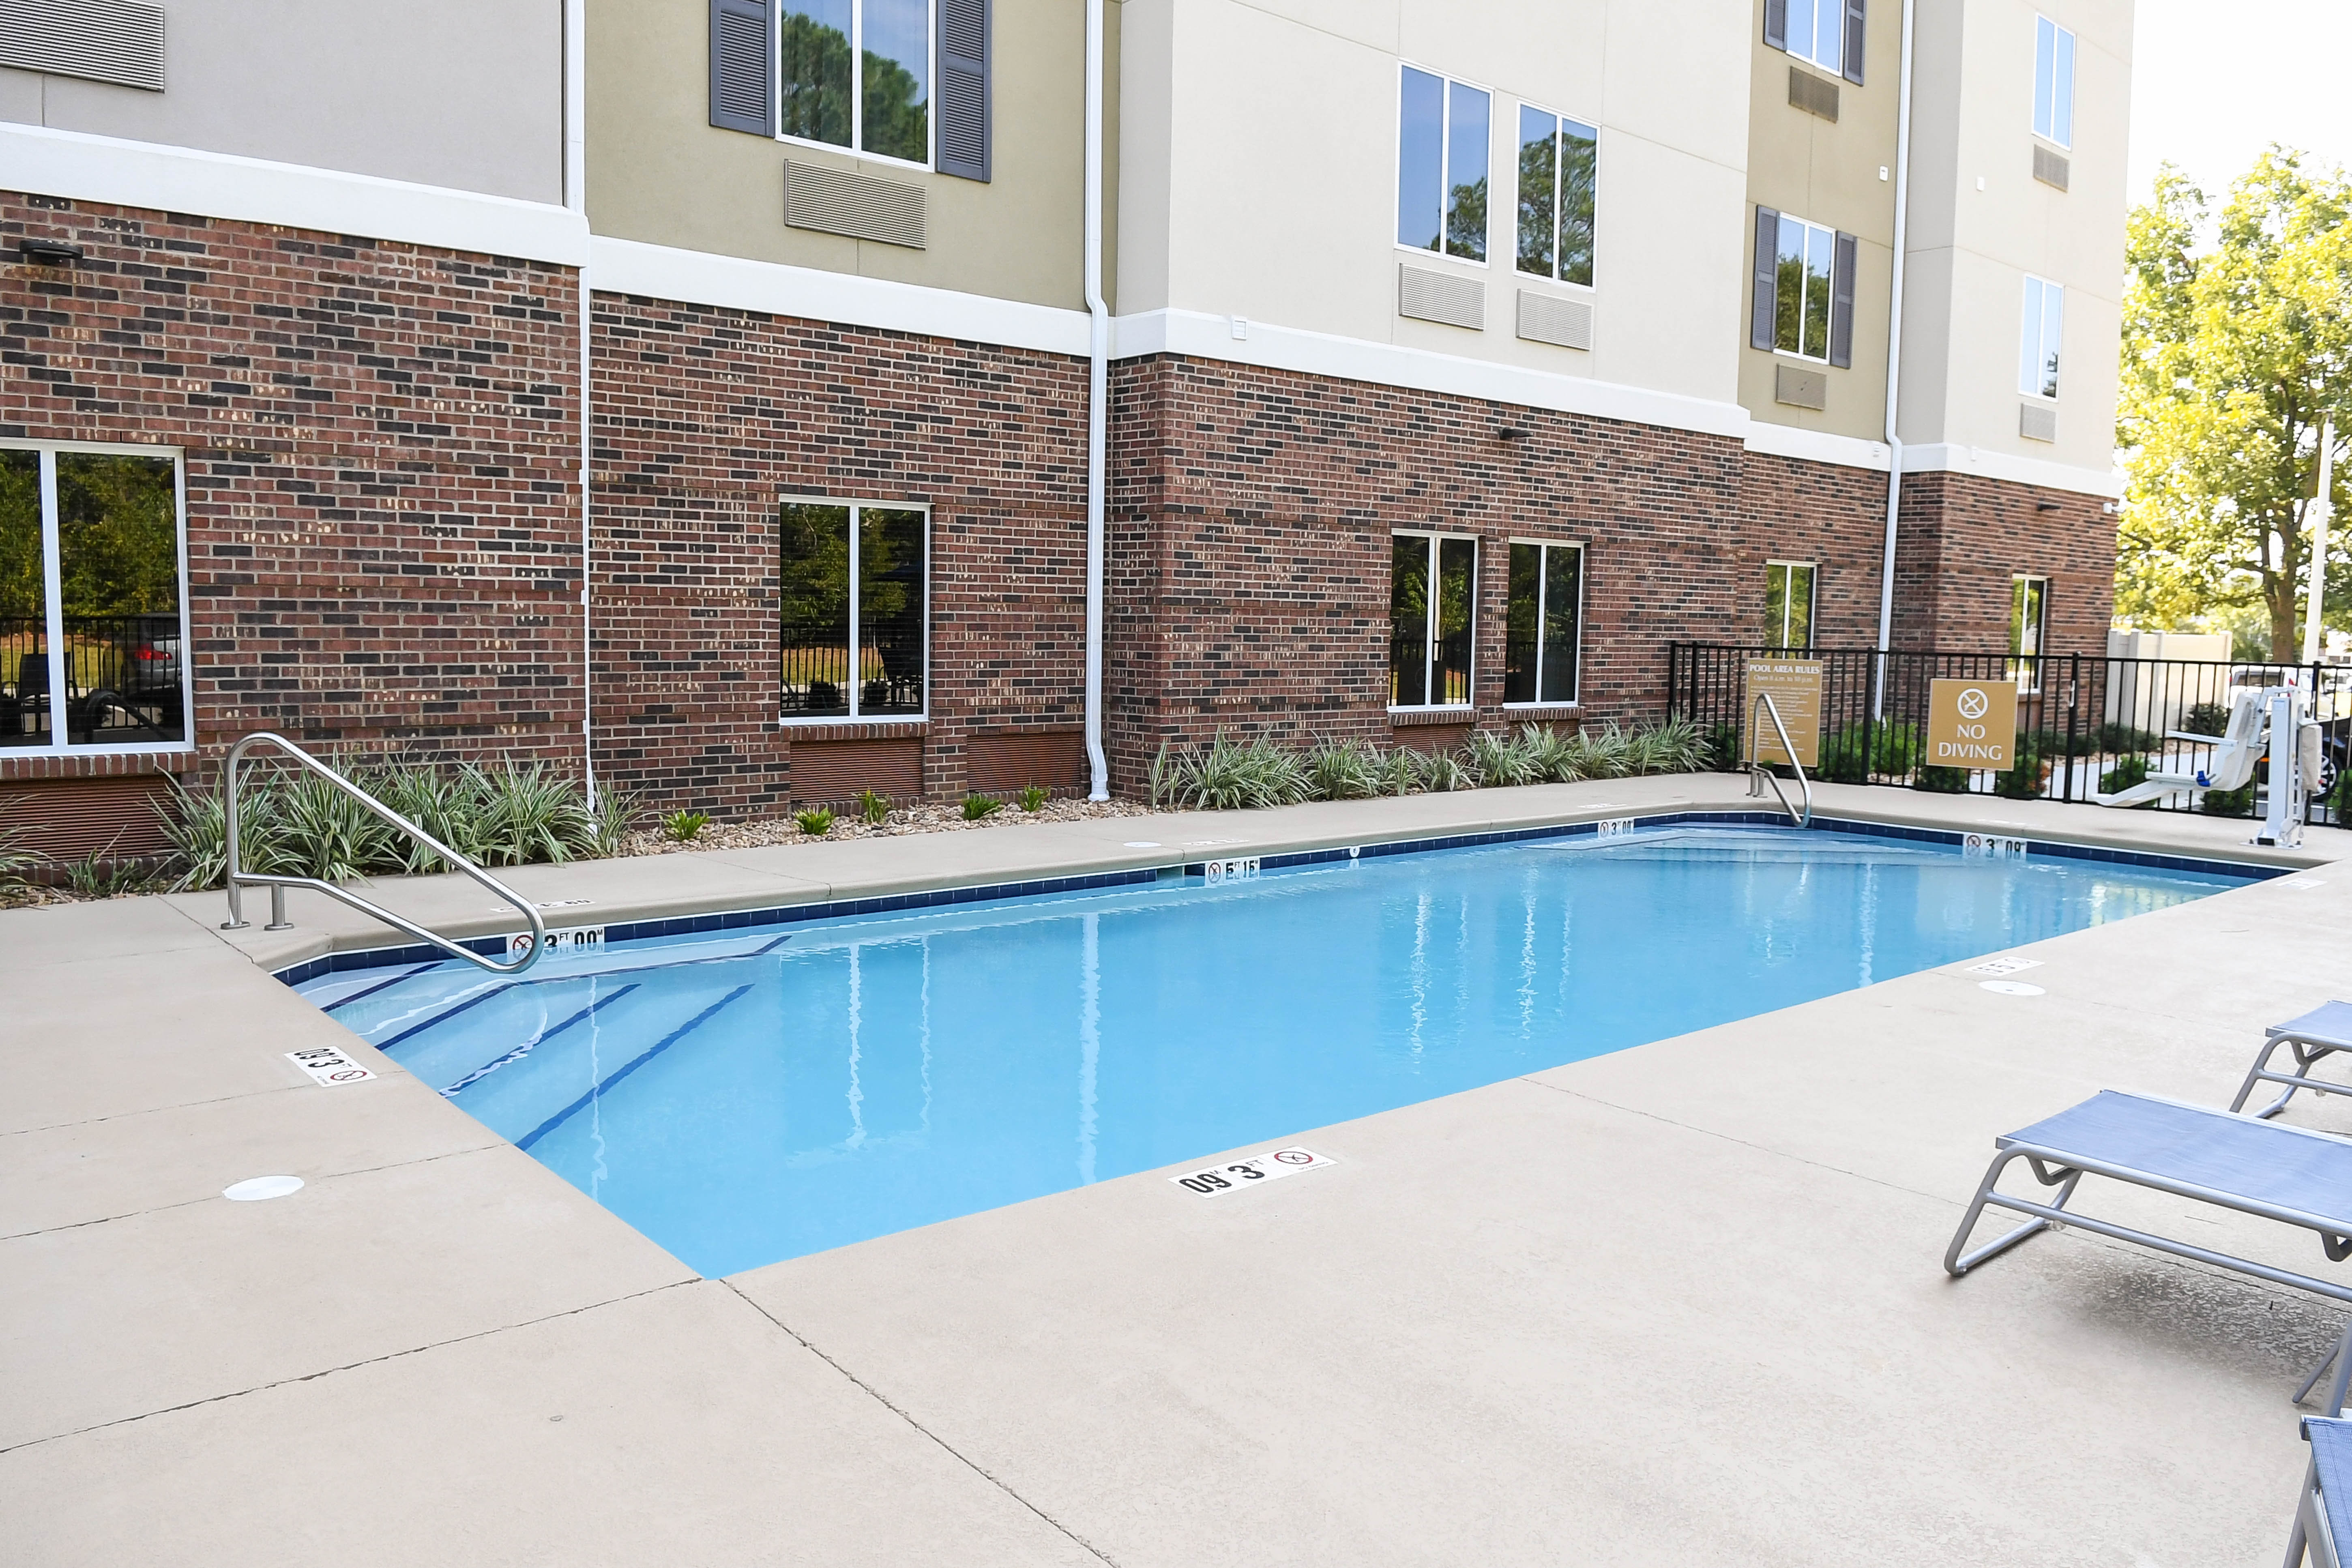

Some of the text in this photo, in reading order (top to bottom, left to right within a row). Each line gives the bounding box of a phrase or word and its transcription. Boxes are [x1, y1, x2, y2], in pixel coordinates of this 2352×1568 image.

[1749, 664, 1820, 674] POOL AREA RULES
[1957, 724, 1986, 740] NO
[1938, 742, 2002, 760] DIVING
[559, 933, 569, 941] FT
[308, 1059, 345, 1067] 3
[1228, 1166, 1265, 1179] 3
